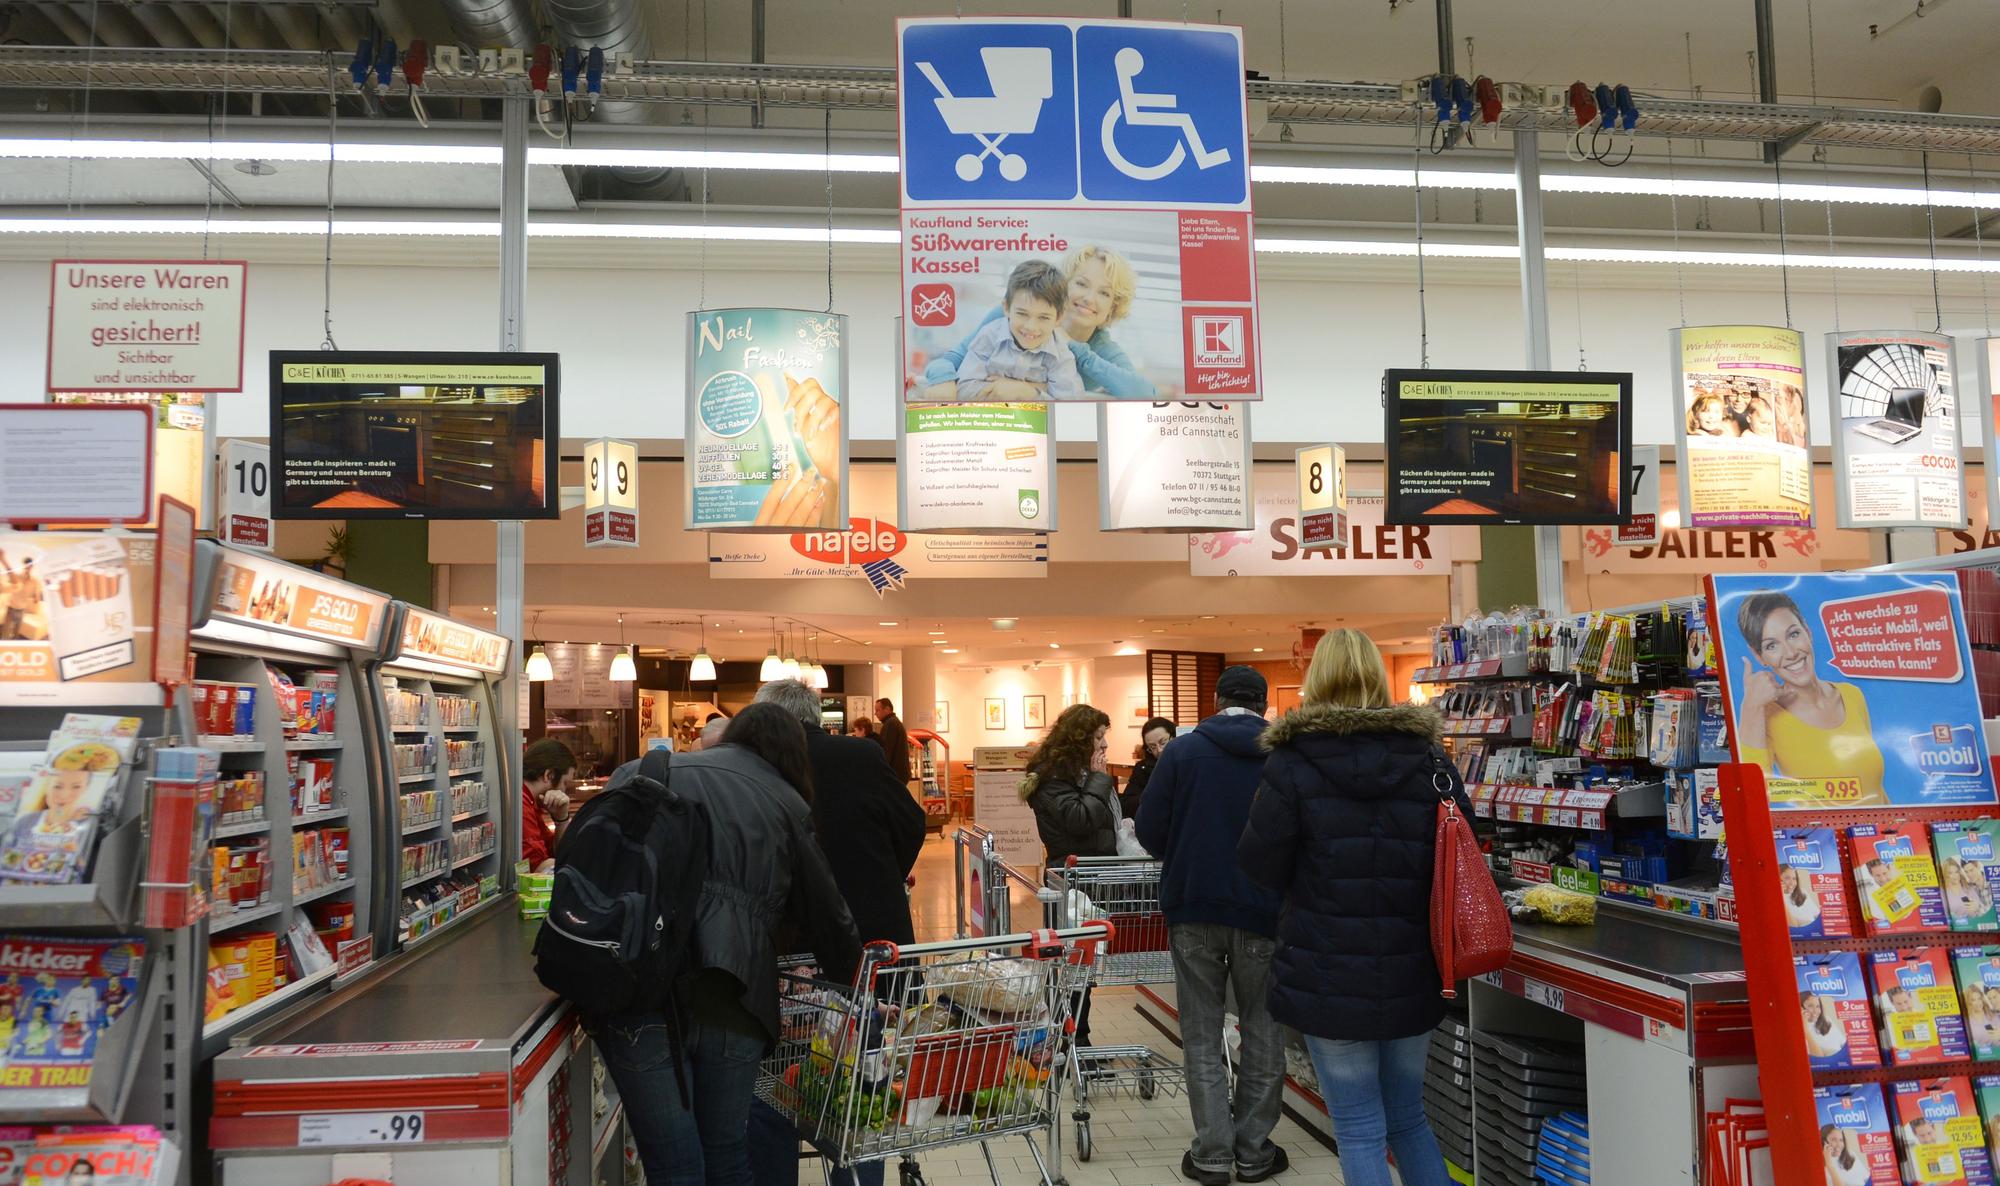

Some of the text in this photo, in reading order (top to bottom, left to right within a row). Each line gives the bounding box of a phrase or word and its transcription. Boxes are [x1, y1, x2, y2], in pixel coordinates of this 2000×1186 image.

[910, 217, 1028, 229] Kaufland Service:
[1200, 218, 1220, 226] Eltern,
[911, 232, 1068, 252] Süßwarenfreie
[912, 256, 980, 274] Kasse!
[68, 269, 229, 289] Unsere Waren
[91, 298, 204, 312] sind elektronisch
[92, 320, 200, 346] gesichert!
[699, 316, 753, 357] Nail
[118, 352, 173, 364] Sichtbar
[1198, 354, 1241, 363] Kaufland
[94, 372, 195, 384] und unsichtbar
[1198, 370, 1230, 384] Hier bin
[1208, 374, 1250, 390] ich richtig!
[1148, 413, 1234, 425] Baugenossenschaft
[1160, 426, 1238, 438] Bad Cannstatt eG
[325, 460, 363, 468] inspirieren
[1186, 459, 1232, 469] Seelbergstraße
[1922, 455, 1957, 470] COCOX
[235, 460, 267, 498] 10
[286, 469, 317, 478] Germany
[359, 470, 392, 478] Beratung
[591, 457, 598, 492] 9
[617, 461, 628, 496] 9
[1214, 472, 1240, 481] Stuttgart
[1310, 462, 1322, 495] 8
[1400, 470, 1422, 478] Küchen
[1434, 470, 1466, 479] inspirieren
[1471, 470, 1488, 478] made
[1488, 470, 1494, 478] in
[286, 479, 300, 488] gibt
[1400, 478, 1426, 488] Germany
[1462, 479, 1490, 488] Beratung
[1632, 465, 1646, 496] 7
[1400, 487, 1413, 495] gibt
[1171, 496, 1241, 504] www.bgc-cannstatt.de
[1168, 508, 1242, 516] info@bgc-cannstatt.de
[232, 518, 268, 530] Bitte nicht
[1637, 516, 1655, 524] nicht
[240, 528, 260, 538] mehr
[1627, 525, 1646, 533] mehr
[332, 600, 358, 622] GOLD
[1854, 604, 1900, 620] wechsle
[1904, 603, 1918, 615] zu
[1832, 617, 1948, 638] K-Classic Mobil, weil
[1837, 638, 1942, 653] ich attraktive Flats
[1842, 656, 1894, 669] zubuchen
[1921, 746, 1974, 766] mobil
[1825, 780, 1858, 799] 9.95
[1880, 848, 1911, 860] mobil
[1961, 844, 1991, 856] mobil
[1789, 853, 1820, 864] mobil
[1557, 869, 1578, 890] feel
[1578, 880, 1589, 890] me?
[1818, 874, 1824, 884] 9
[0, 944, 92, 970] kicker
[1812, 978, 1844, 991] mobil
[1902, 974, 1932, 986] mobil
[1544, 986, 1564, 1010] 4.99
[1842, 1001, 1850, 1010] 9
[1852, 1020, 1860, 1029] 10
[1834, 1110, 1866, 1124] mobil
[1924, 1104, 1956, 1118] mobil
[370, 1114, 422, 1140] -.99
[1866, 1133, 1872, 1144] 9
[1874, 1154, 1883, 1162] 10
